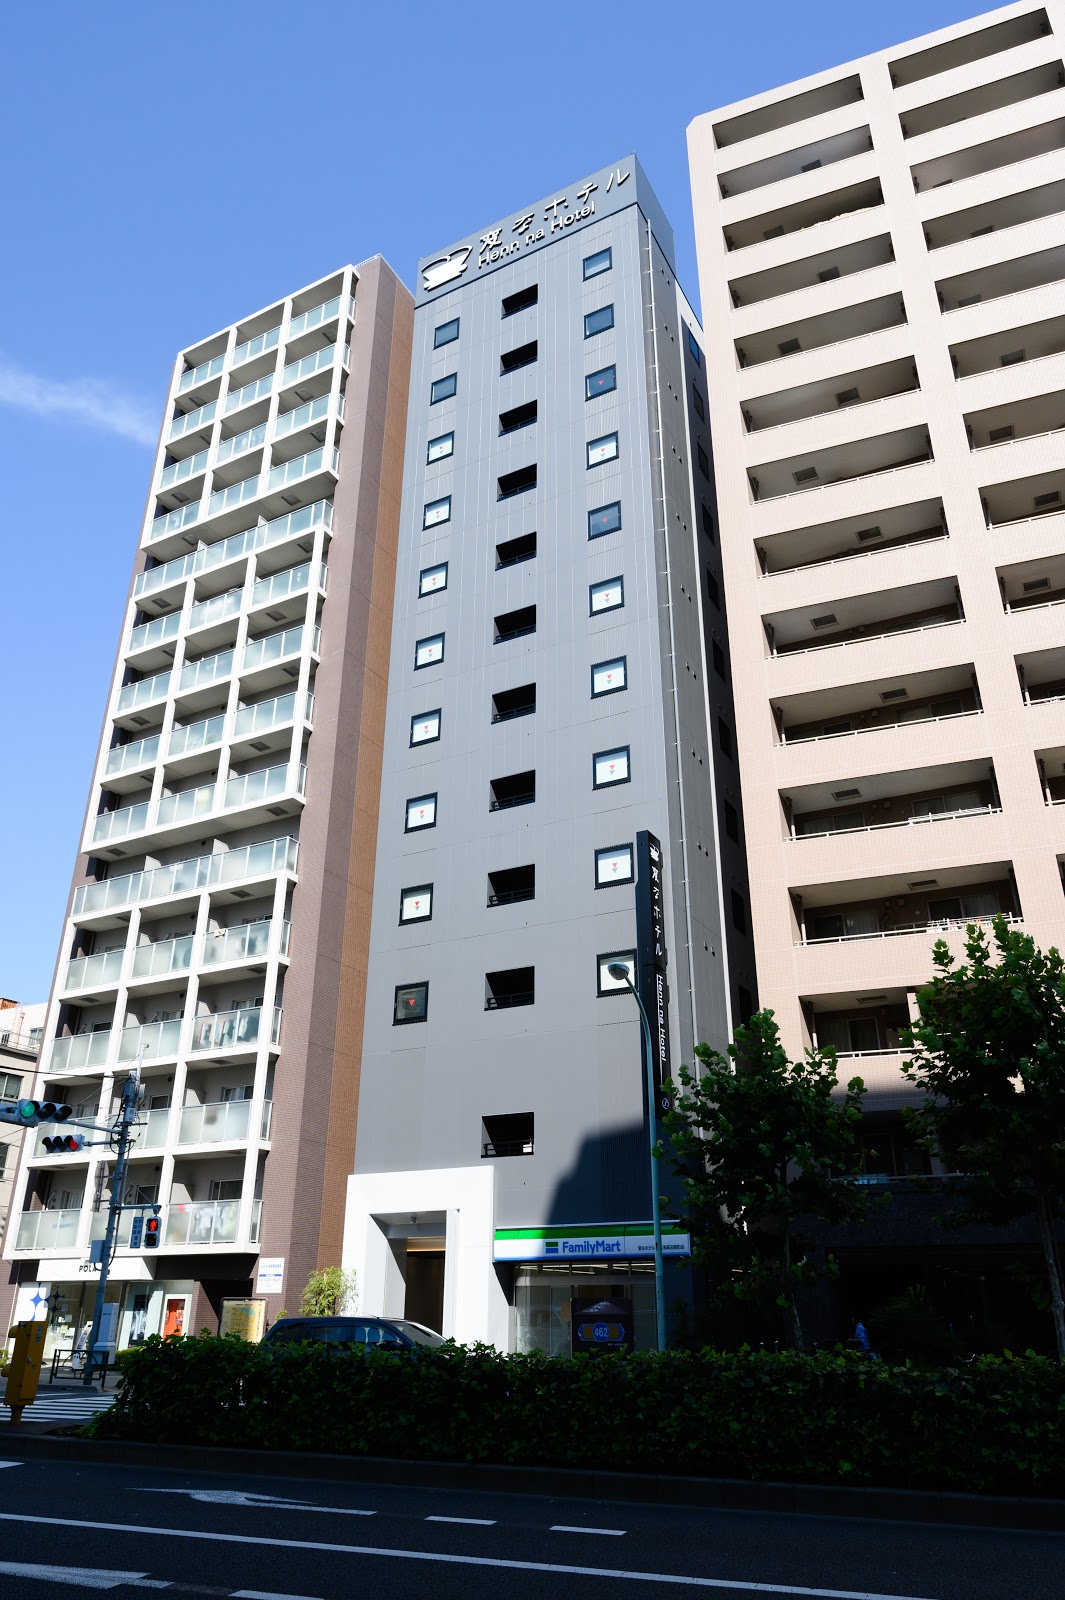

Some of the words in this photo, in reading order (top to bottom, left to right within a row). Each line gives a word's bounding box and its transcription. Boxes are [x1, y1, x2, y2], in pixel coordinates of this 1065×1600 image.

[478, 240, 520, 269] Henn
[525, 228, 545, 246] na
[550, 200, 596, 234] Hotel
[479, 168, 631, 254] 変なホテル
[651, 866, 663, 956] 変なホテル
[562, 1240, 621, 1255] FamilyMart
[594, 1327, 608, 1338] 462
